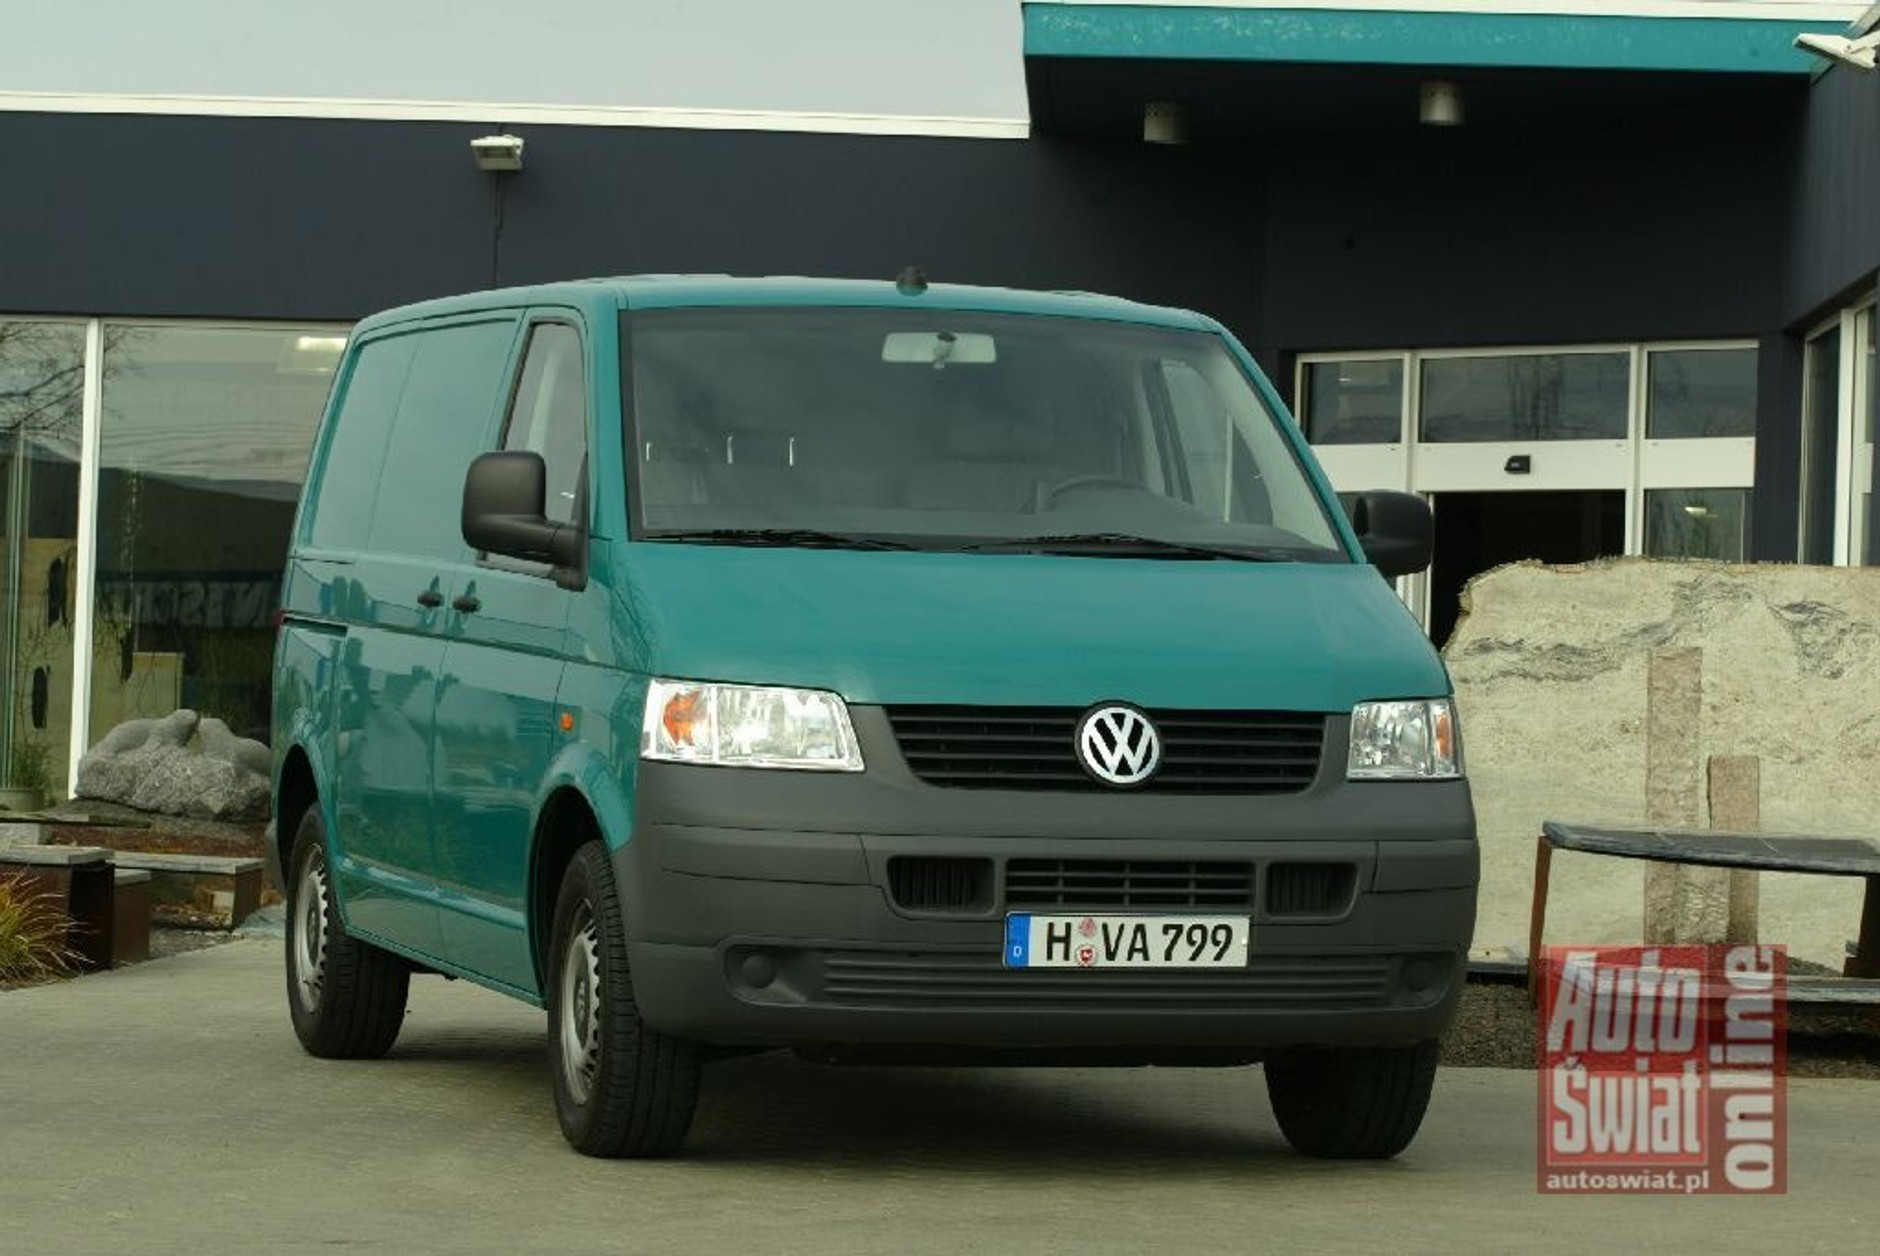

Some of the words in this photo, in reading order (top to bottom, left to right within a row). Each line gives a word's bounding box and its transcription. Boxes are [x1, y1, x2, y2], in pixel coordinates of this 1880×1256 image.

[1081, 706, 1160, 784] VW
[1046, 922, 1072, 962] H
[1101, 922, 1150, 962] VA
[1162, 923, 1233, 962] 799
